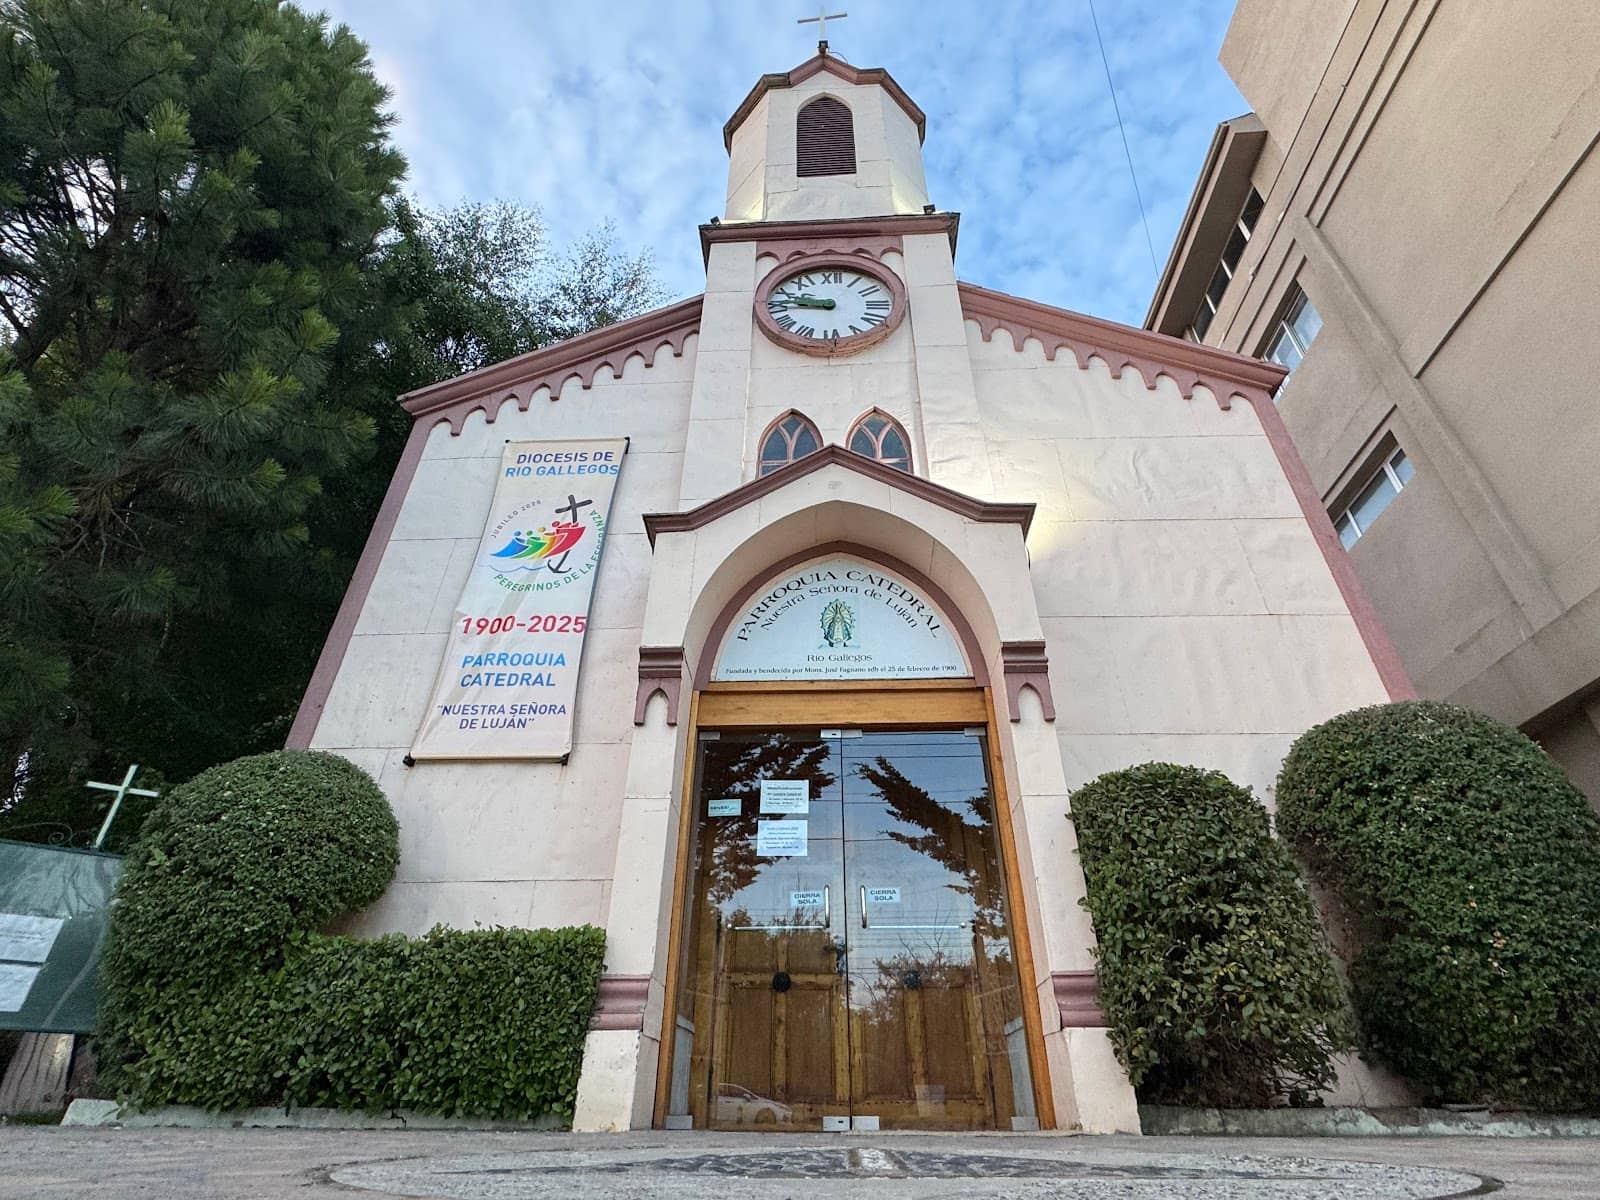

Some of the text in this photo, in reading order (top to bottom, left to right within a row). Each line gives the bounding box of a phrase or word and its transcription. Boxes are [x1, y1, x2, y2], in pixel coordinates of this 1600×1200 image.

[790, 274, 816, 291] XI
[820, 271, 843, 285] XII
[846, 276, 863, 288] I
[857, 284, 882, 298] II
[864, 300, 890, 310] III
[860, 312, 888, 326] IV
[516, 451, 615, 465] DIOCESIS DE
[505, 464, 619, 478] RIO GALLEGOS
[490, 510, 519, 539] JUBILEO
[494, 509, 606, 593] PEREGRINOS DE LA ESRANZA
[736, 569, 941, 641] PARROQUIA CATEDRAL
[760, 594, 806, 631] Nuestra
[808, 583, 859, 597] Señora
[863, 587, 882, 600] de
[461, 614, 587, 635] 1900-2025
[461, 652, 567, 669] PARROQUIA
[828, 653, 873, 663] Gallegos
[931, 664, 941, 672] de
[941, 664, 958, 672] 1900
[459, 672, 557, 688] CATEDRAL
[508, 701, 567, 715] SEÑORA
[458, 718, 479, 730] DE
